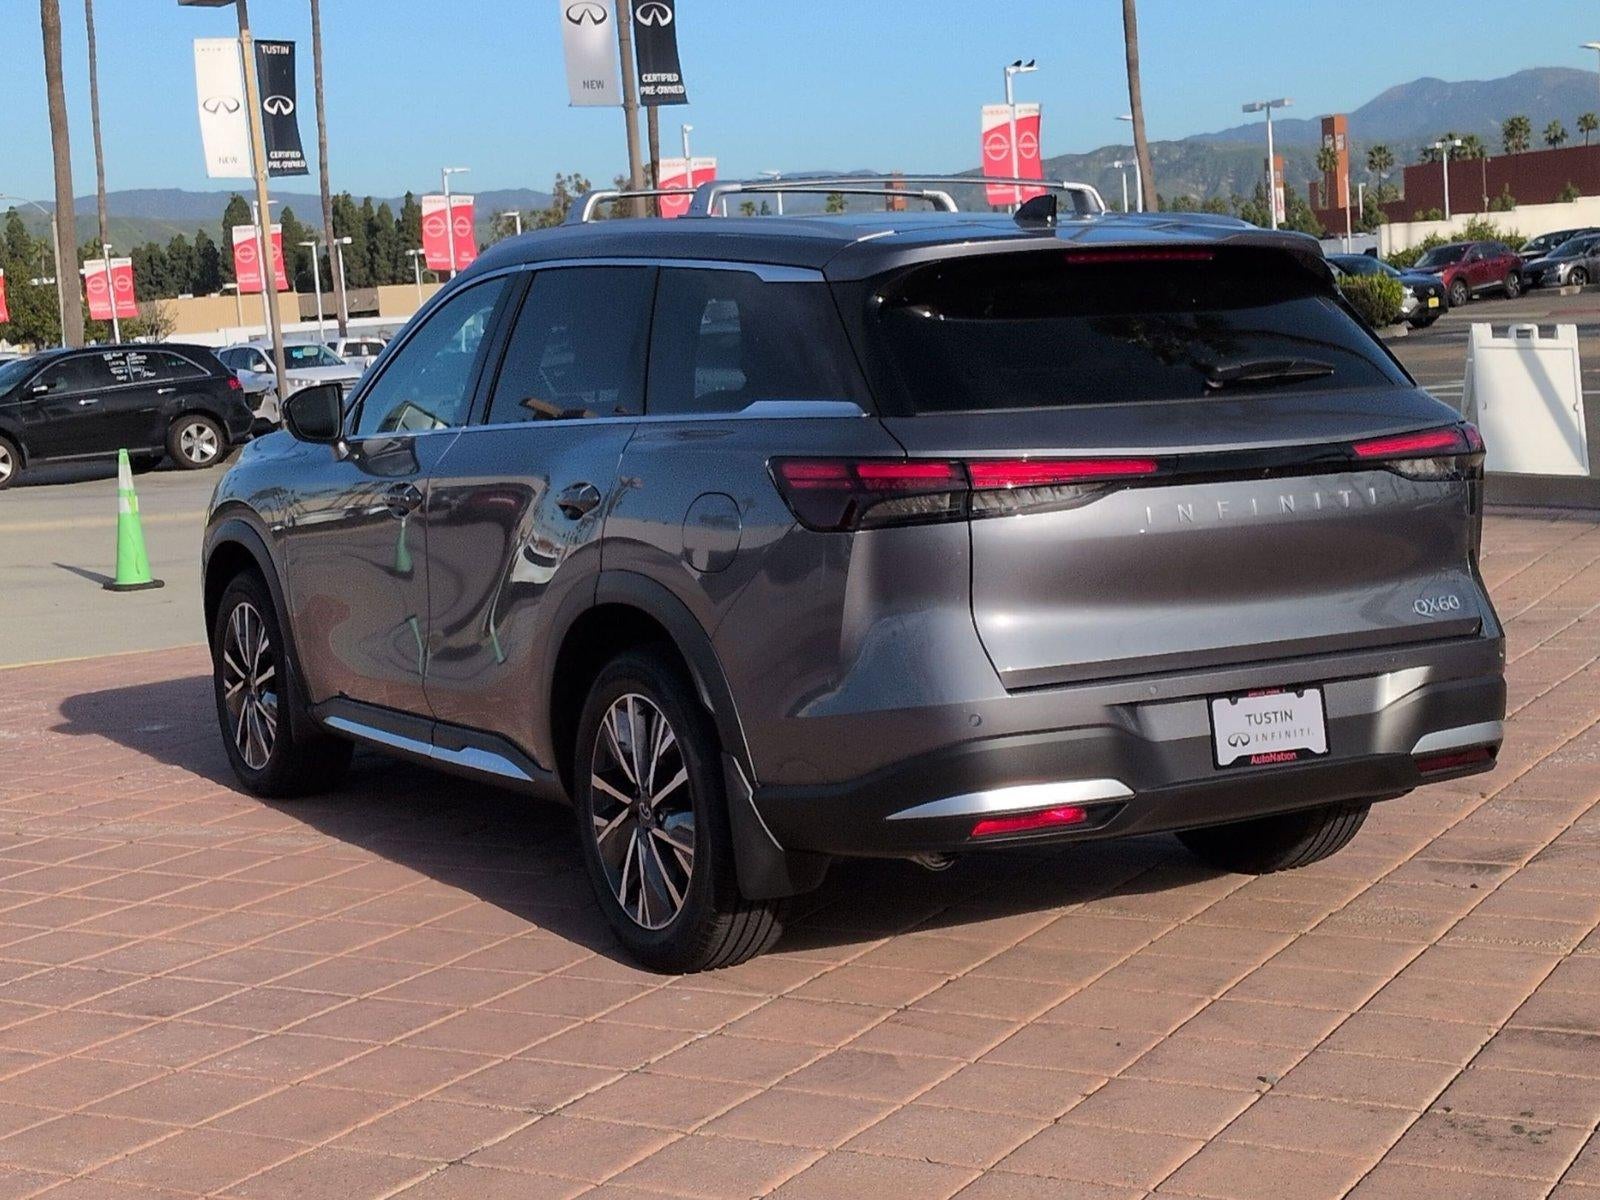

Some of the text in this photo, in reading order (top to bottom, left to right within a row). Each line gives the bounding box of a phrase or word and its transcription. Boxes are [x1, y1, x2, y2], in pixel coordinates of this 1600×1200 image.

[260, 45, 290, 55] TUSTIN
[642, 73, 679, 82] CERTIFIED
[583, 80, 605, 90] NEW
[640, 85, 685, 95] PRE-OWNED
[1145, 487, 1377, 525] INFINITI
[1413, 595, 1461, 616] QX60
[1245, 710, 1294, 726] TUSTIN
[1255, 728, 1311, 742] INFINITI
[1250, 752, 1297, 765] AutoNation
